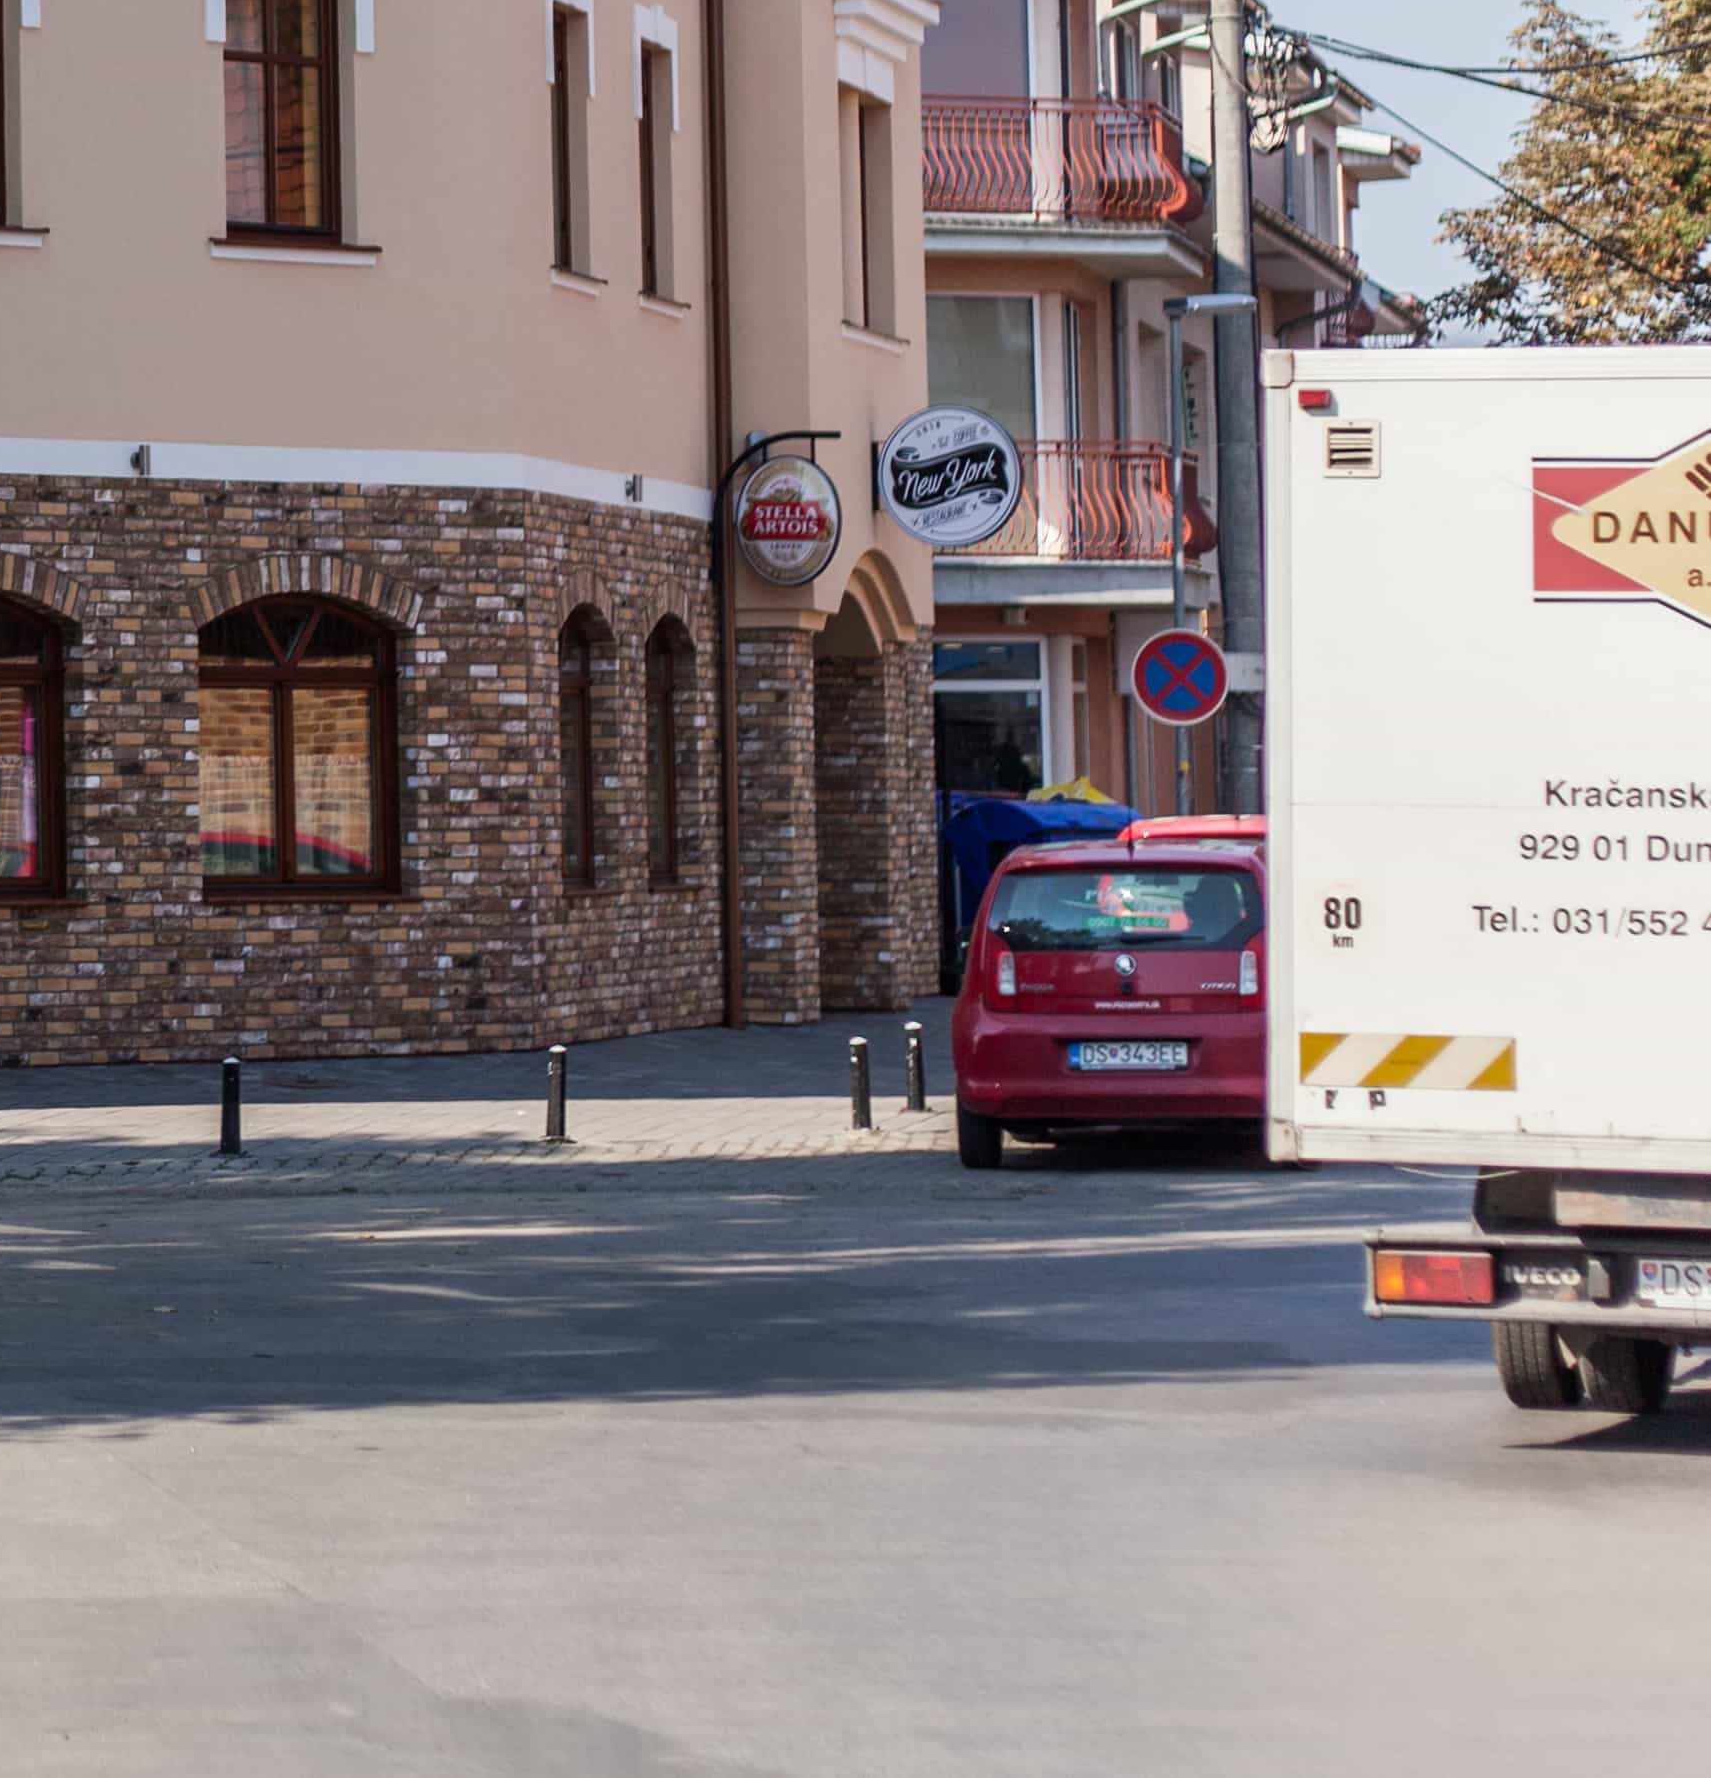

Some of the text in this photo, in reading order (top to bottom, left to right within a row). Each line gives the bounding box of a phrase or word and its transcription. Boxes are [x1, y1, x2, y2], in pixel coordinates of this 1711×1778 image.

[898, 448, 998, 503] New York
[754, 505, 818, 519] STELLA
[1592, 510, 1711, 543] DAN
[753, 520, 819, 534] ARTOIS
[1544, 778, 1711, 809] Kračansk
[1519, 834, 1580, 861] 929
[1592, 834, 1628, 861] 01
[1324, 897, 1362, 930] 80
[1471, 905, 1539, 933] Tel.:
[1552, 907, 1689, 938] 031/552
[1332, 933, 1355, 948] km
[1082, 1044, 1186, 1064] DS 343EE
[1504, 1265, 1581, 1286] IVECO
[1661, 1263, 1703, 1297] DS
